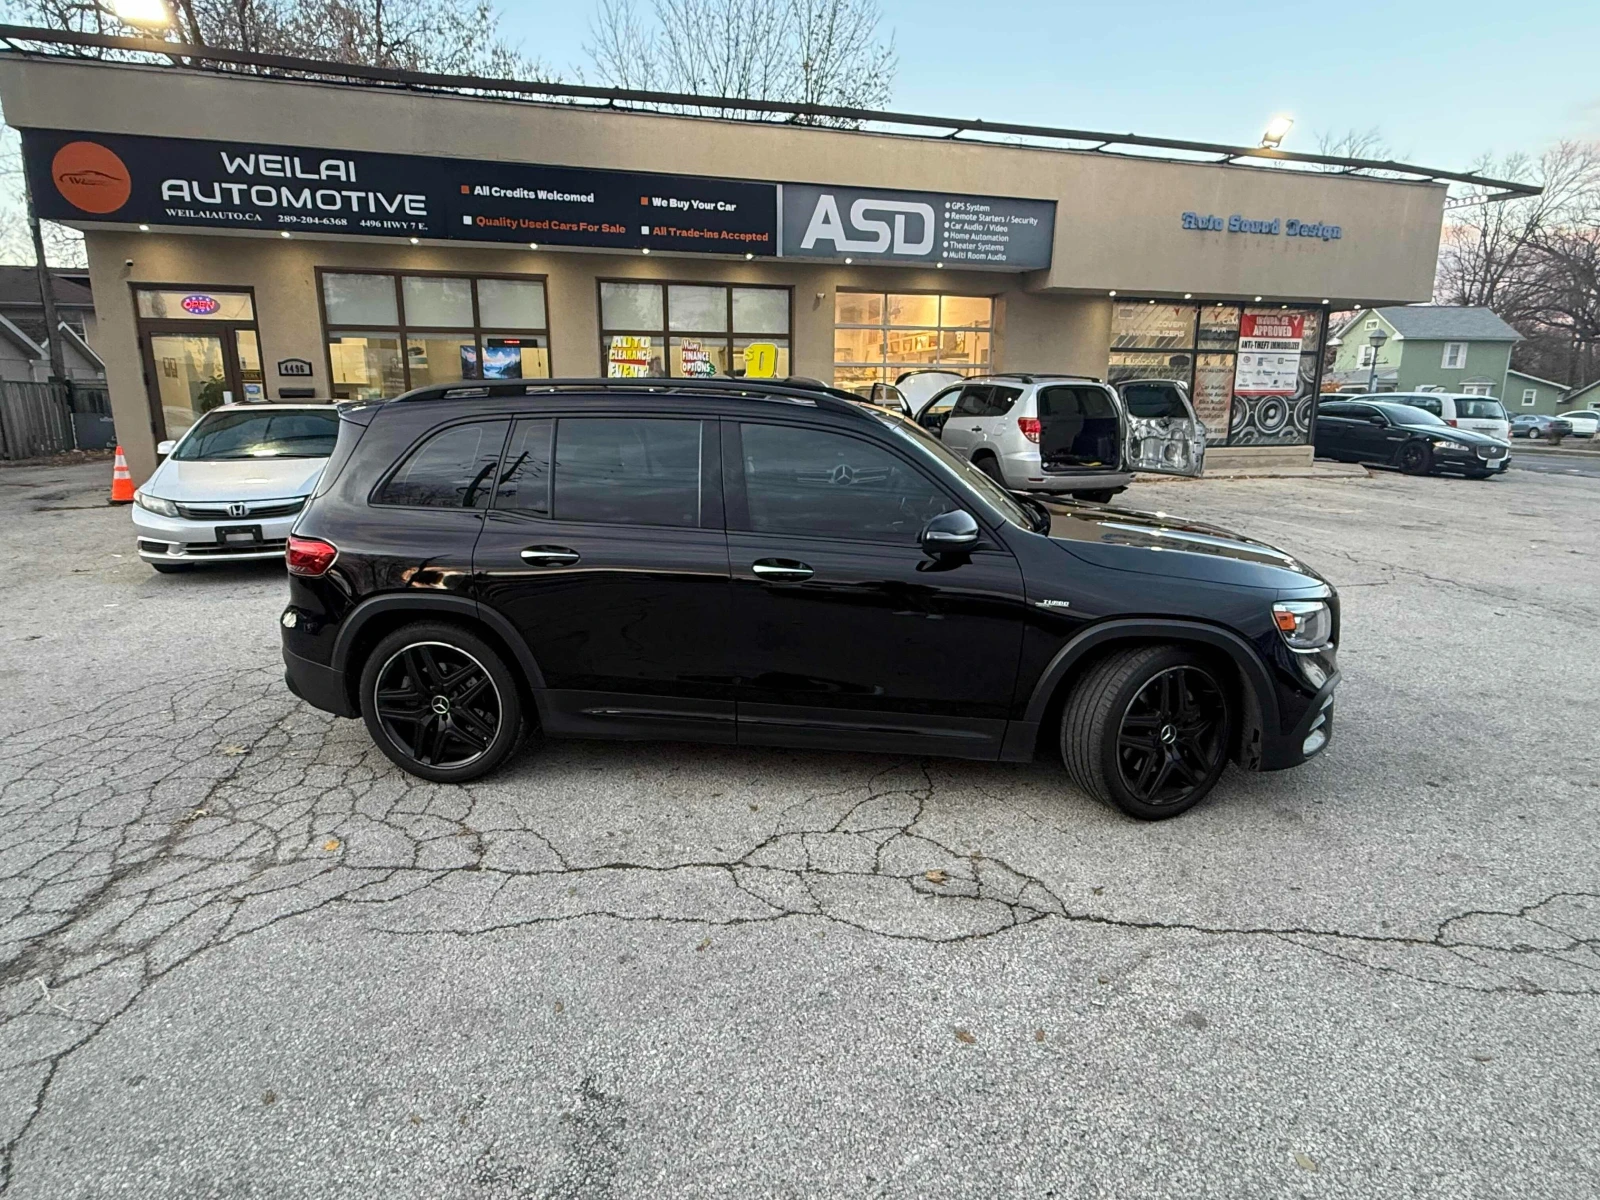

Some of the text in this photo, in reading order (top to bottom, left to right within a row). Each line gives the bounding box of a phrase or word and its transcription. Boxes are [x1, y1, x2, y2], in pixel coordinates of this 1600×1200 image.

[221, 152, 356, 182] WEILAI
[161, 179, 427, 215] AUTOMOTIVE
[474, 185, 595, 203] All Credits Welcomed
[652, 197, 736, 211] We Buy Your Car
[951, 202, 990, 212] GPS System
[165, 208, 263, 222] WEILAIAUTO.CA
[278, 214, 348, 227] 289-204-6368
[951, 212, 977, 220] Remote
[978, 214, 1005, 223] Starters
[1011, 216, 1039, 226] Security
[359, 219, 382, 229] 4496
[383, 220, 409, 230] HWY
[410, 221, 416, 230] 7
[476, 216, 626, 233] Quality Used Cars For Sale
[800, 194, 935, 255] ASD
[950, 221, 962, 229] Car
[963, 222, 983, 231] Audio
[989, 224, 1008, 232] Video
[1182, 212, 1342, 241] Auto Sound Design
[653, 226, 769, 242] All Trade-ins Accepted
[950, 231, 1009, 242] Home Automation
[949, 241, 1004, 252] Theater Systems
[948, 251, 966, 259] Multi
[183, 300, 215, 310] OPEN
[1256, 316, 1289, 325] INSURACE
[1253, 325, 1292, 337] APPROVED
[612, 336, 650, 348] AUTO
[1241, 340, 1269, 349] ANTI-THEFT
[610, 349, 652, 361] CLEARANCE
[683, 351, 710, 361] FINANCE
[285, 364, 304, 373] 4496
[683, 361, 710, 372] OPTIONS
